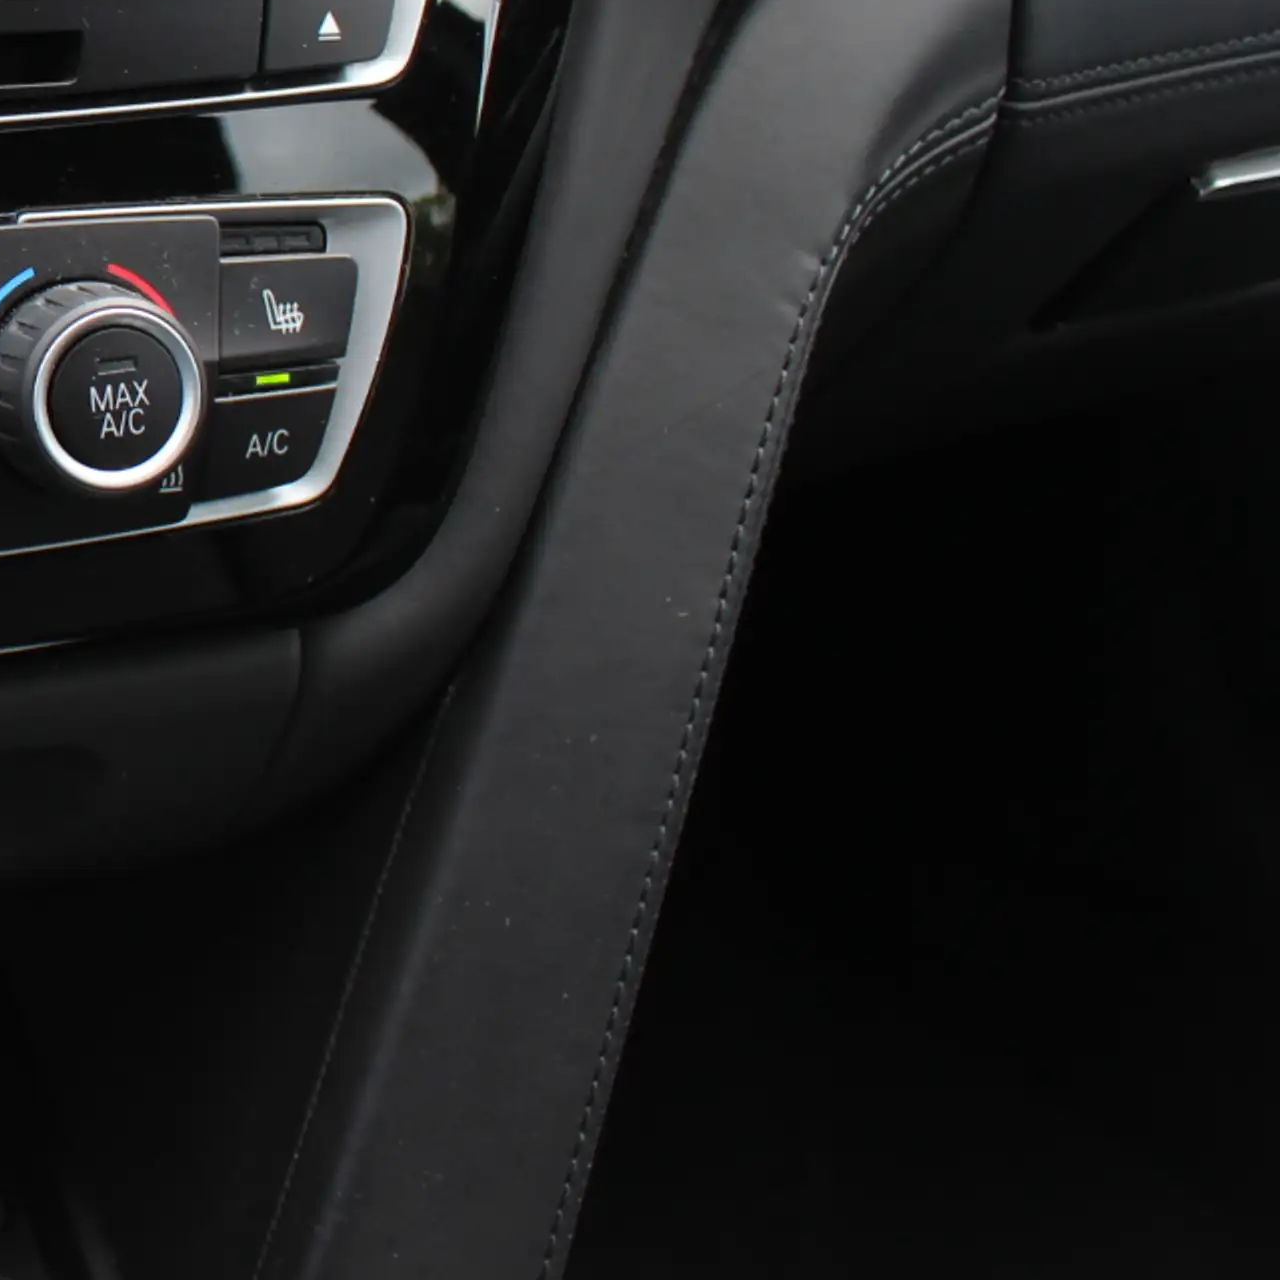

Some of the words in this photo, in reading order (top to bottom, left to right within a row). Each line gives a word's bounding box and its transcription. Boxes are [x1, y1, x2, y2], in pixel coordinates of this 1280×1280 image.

[89, 383, 150, 412] MAX
[100, 407, 146, 439] A/C
[245, 428, 289, 460] A/C
